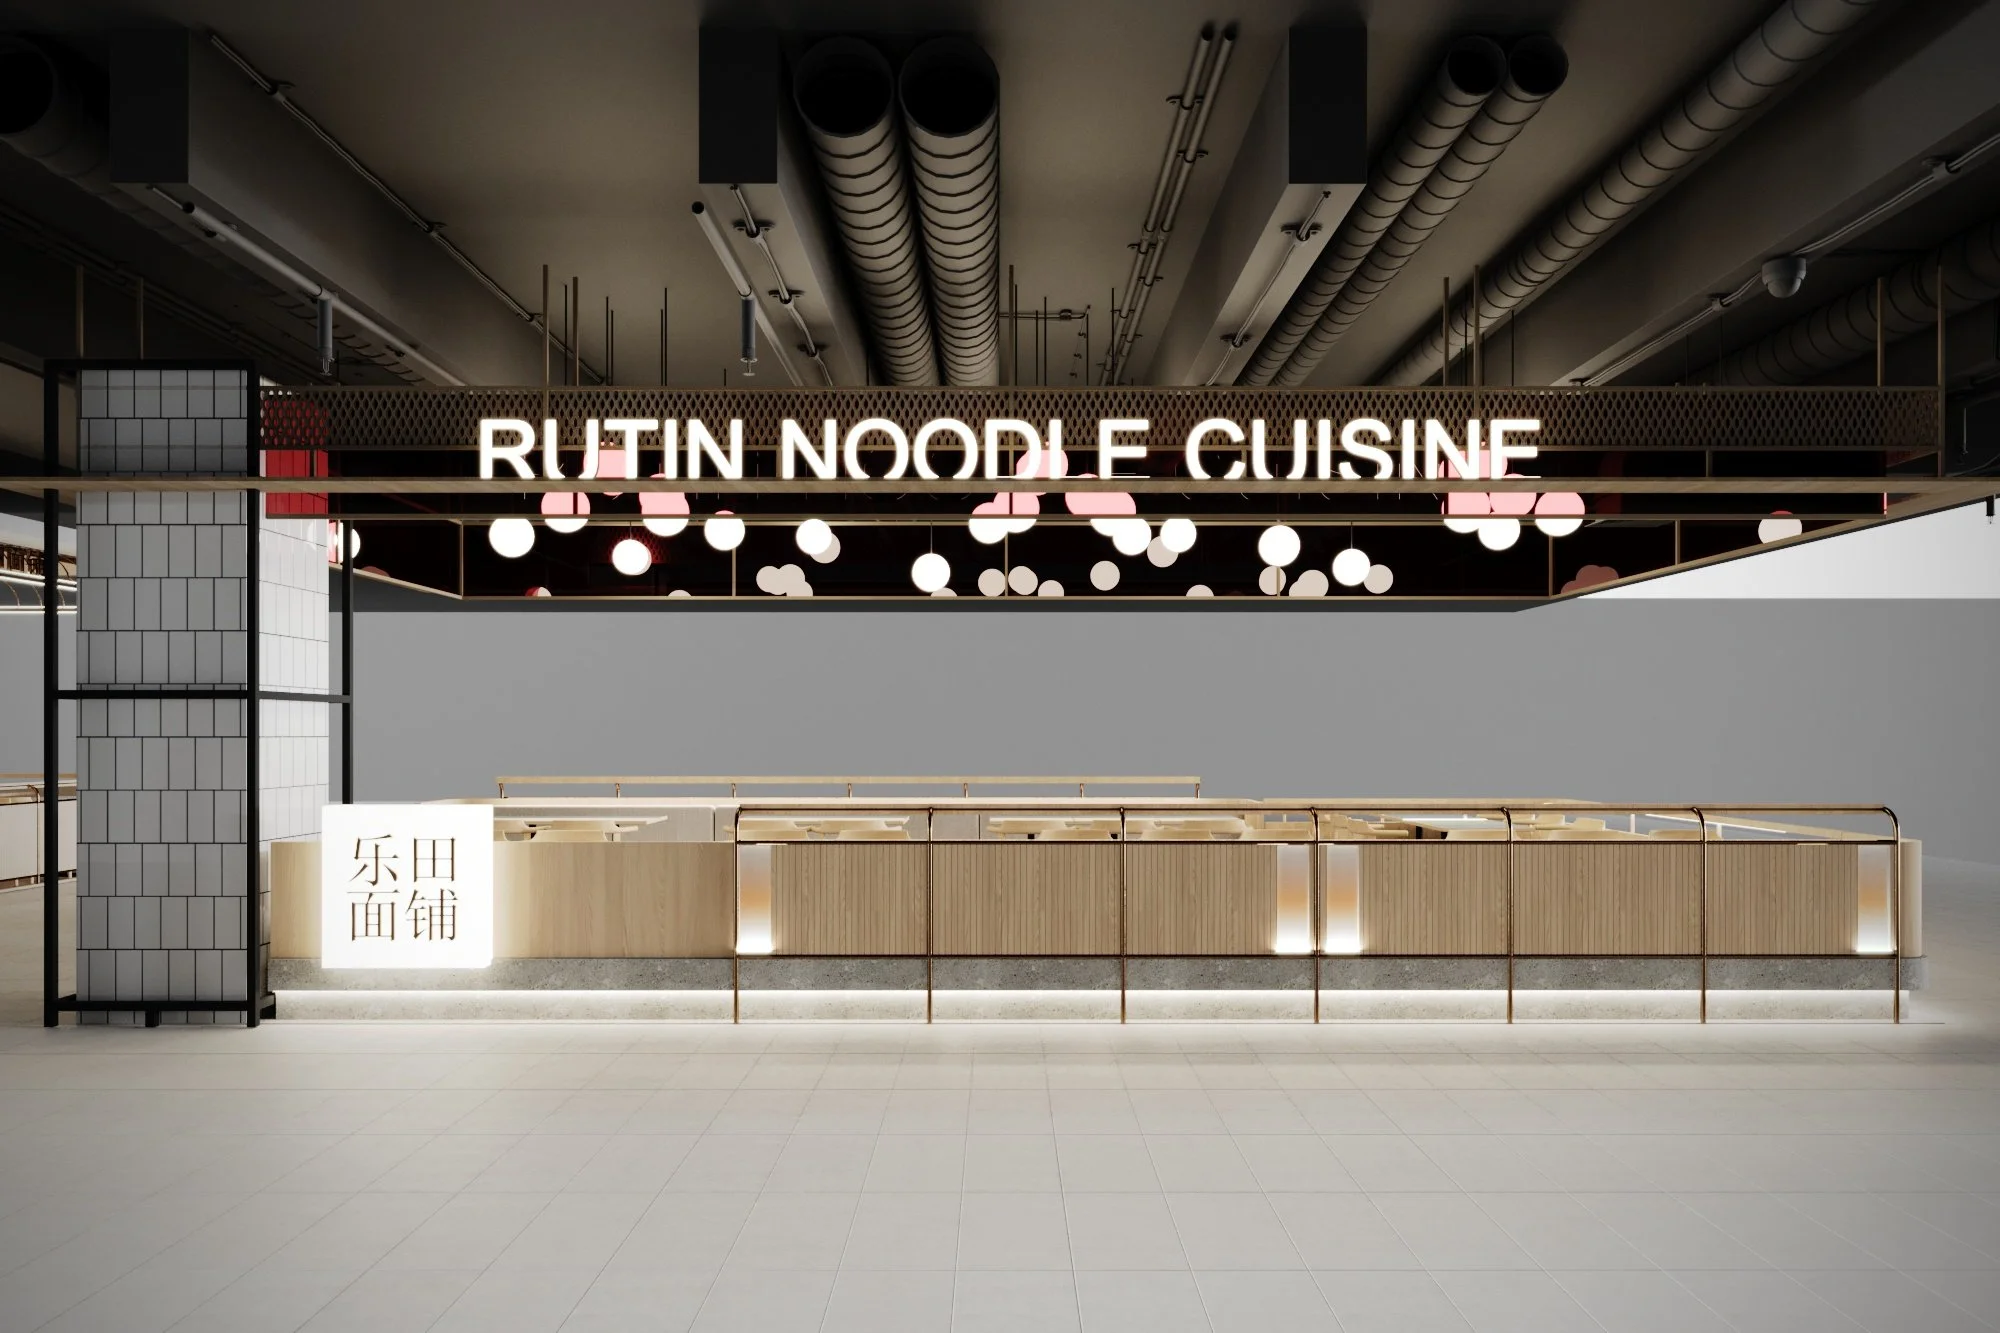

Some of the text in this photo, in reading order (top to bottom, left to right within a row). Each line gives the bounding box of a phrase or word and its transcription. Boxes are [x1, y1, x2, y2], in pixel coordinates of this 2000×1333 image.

[478, 417, 1542, 480] RUTIN NOODLE CUISINE
[347, 834, 456, 886] 乐田
[347, 888, 458, 941] 面铺
